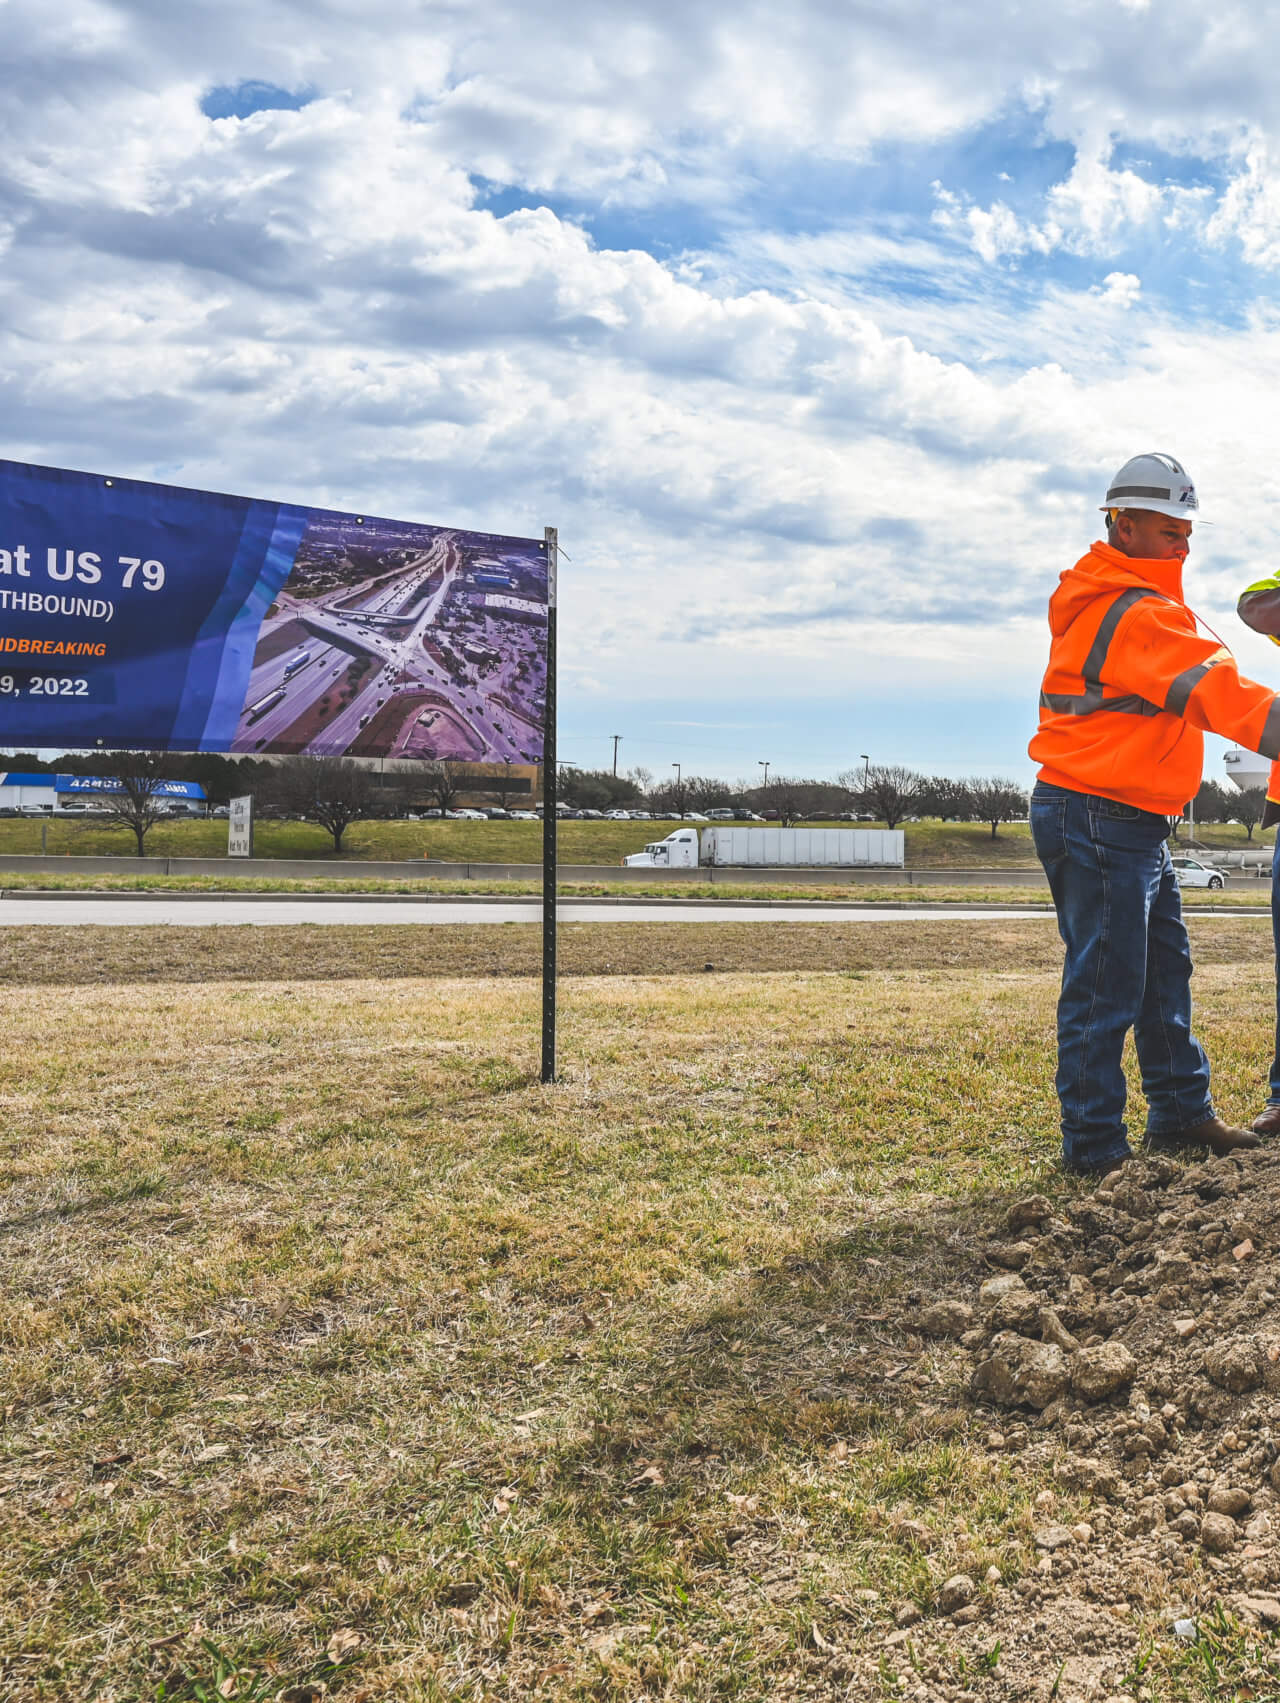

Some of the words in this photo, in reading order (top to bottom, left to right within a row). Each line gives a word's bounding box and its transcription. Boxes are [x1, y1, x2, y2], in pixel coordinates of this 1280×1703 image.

[47, 548, 102, 584] US
[118, 556, 165, 591] 79
[29, 676, 89, 696] 2022
